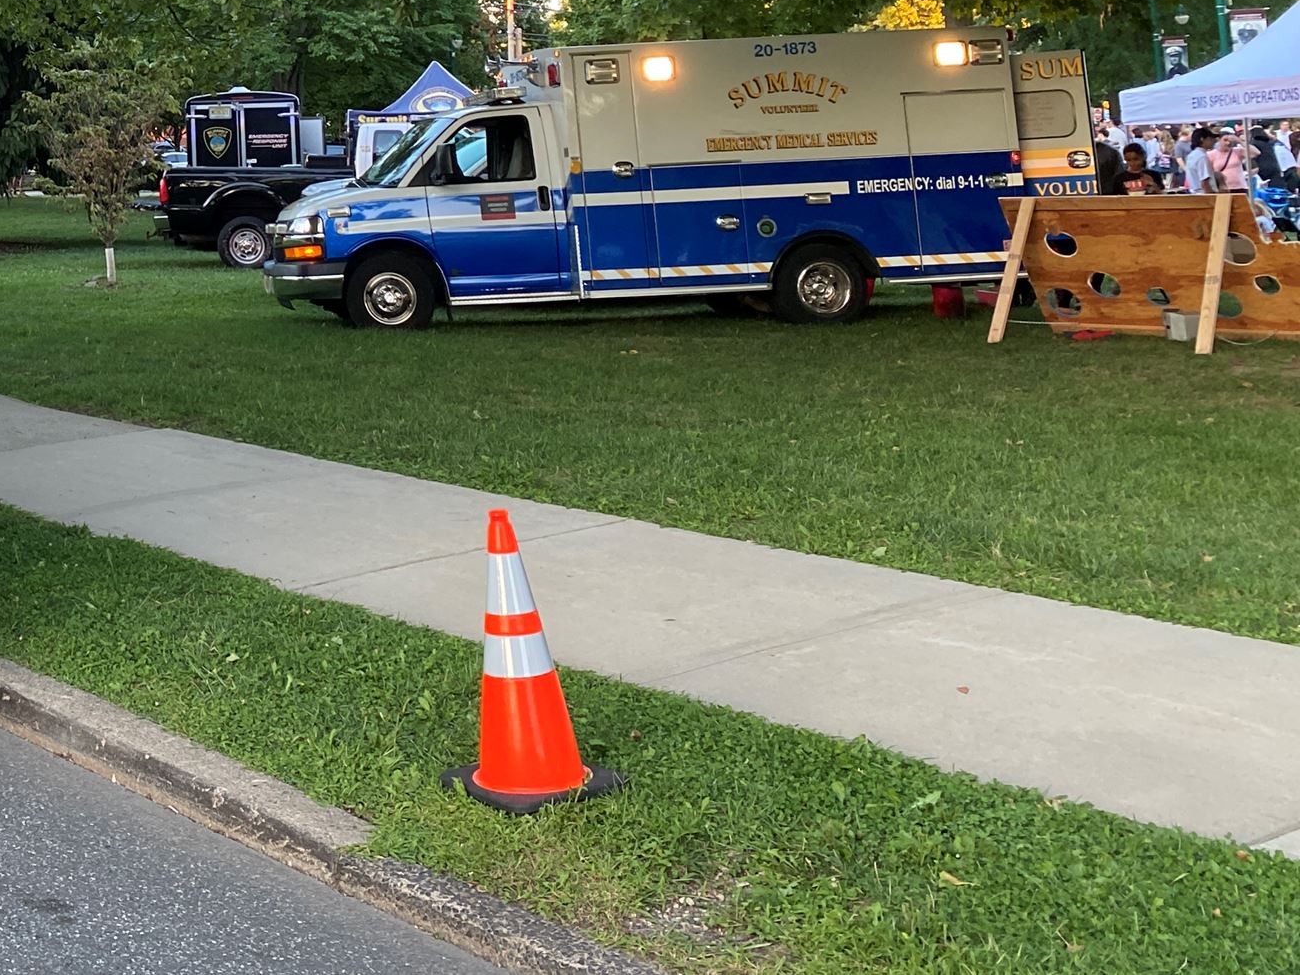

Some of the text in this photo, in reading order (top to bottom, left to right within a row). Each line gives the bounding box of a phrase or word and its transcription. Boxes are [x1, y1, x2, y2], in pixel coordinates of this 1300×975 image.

[754, 41, 817, 57] 20-1873
[727, 71, 849, 109] SUMMIT
[1192, 87, 1300, 109] EMS SPECIAL OPERATIONS
[760, 104, 820, 115] VOLUNTEER
[706, 130, 878, 152] EMERGENCY MEDICAL SERVICES
[857, 174, 985, 193] EMERGENCY: dial 9-1-1
